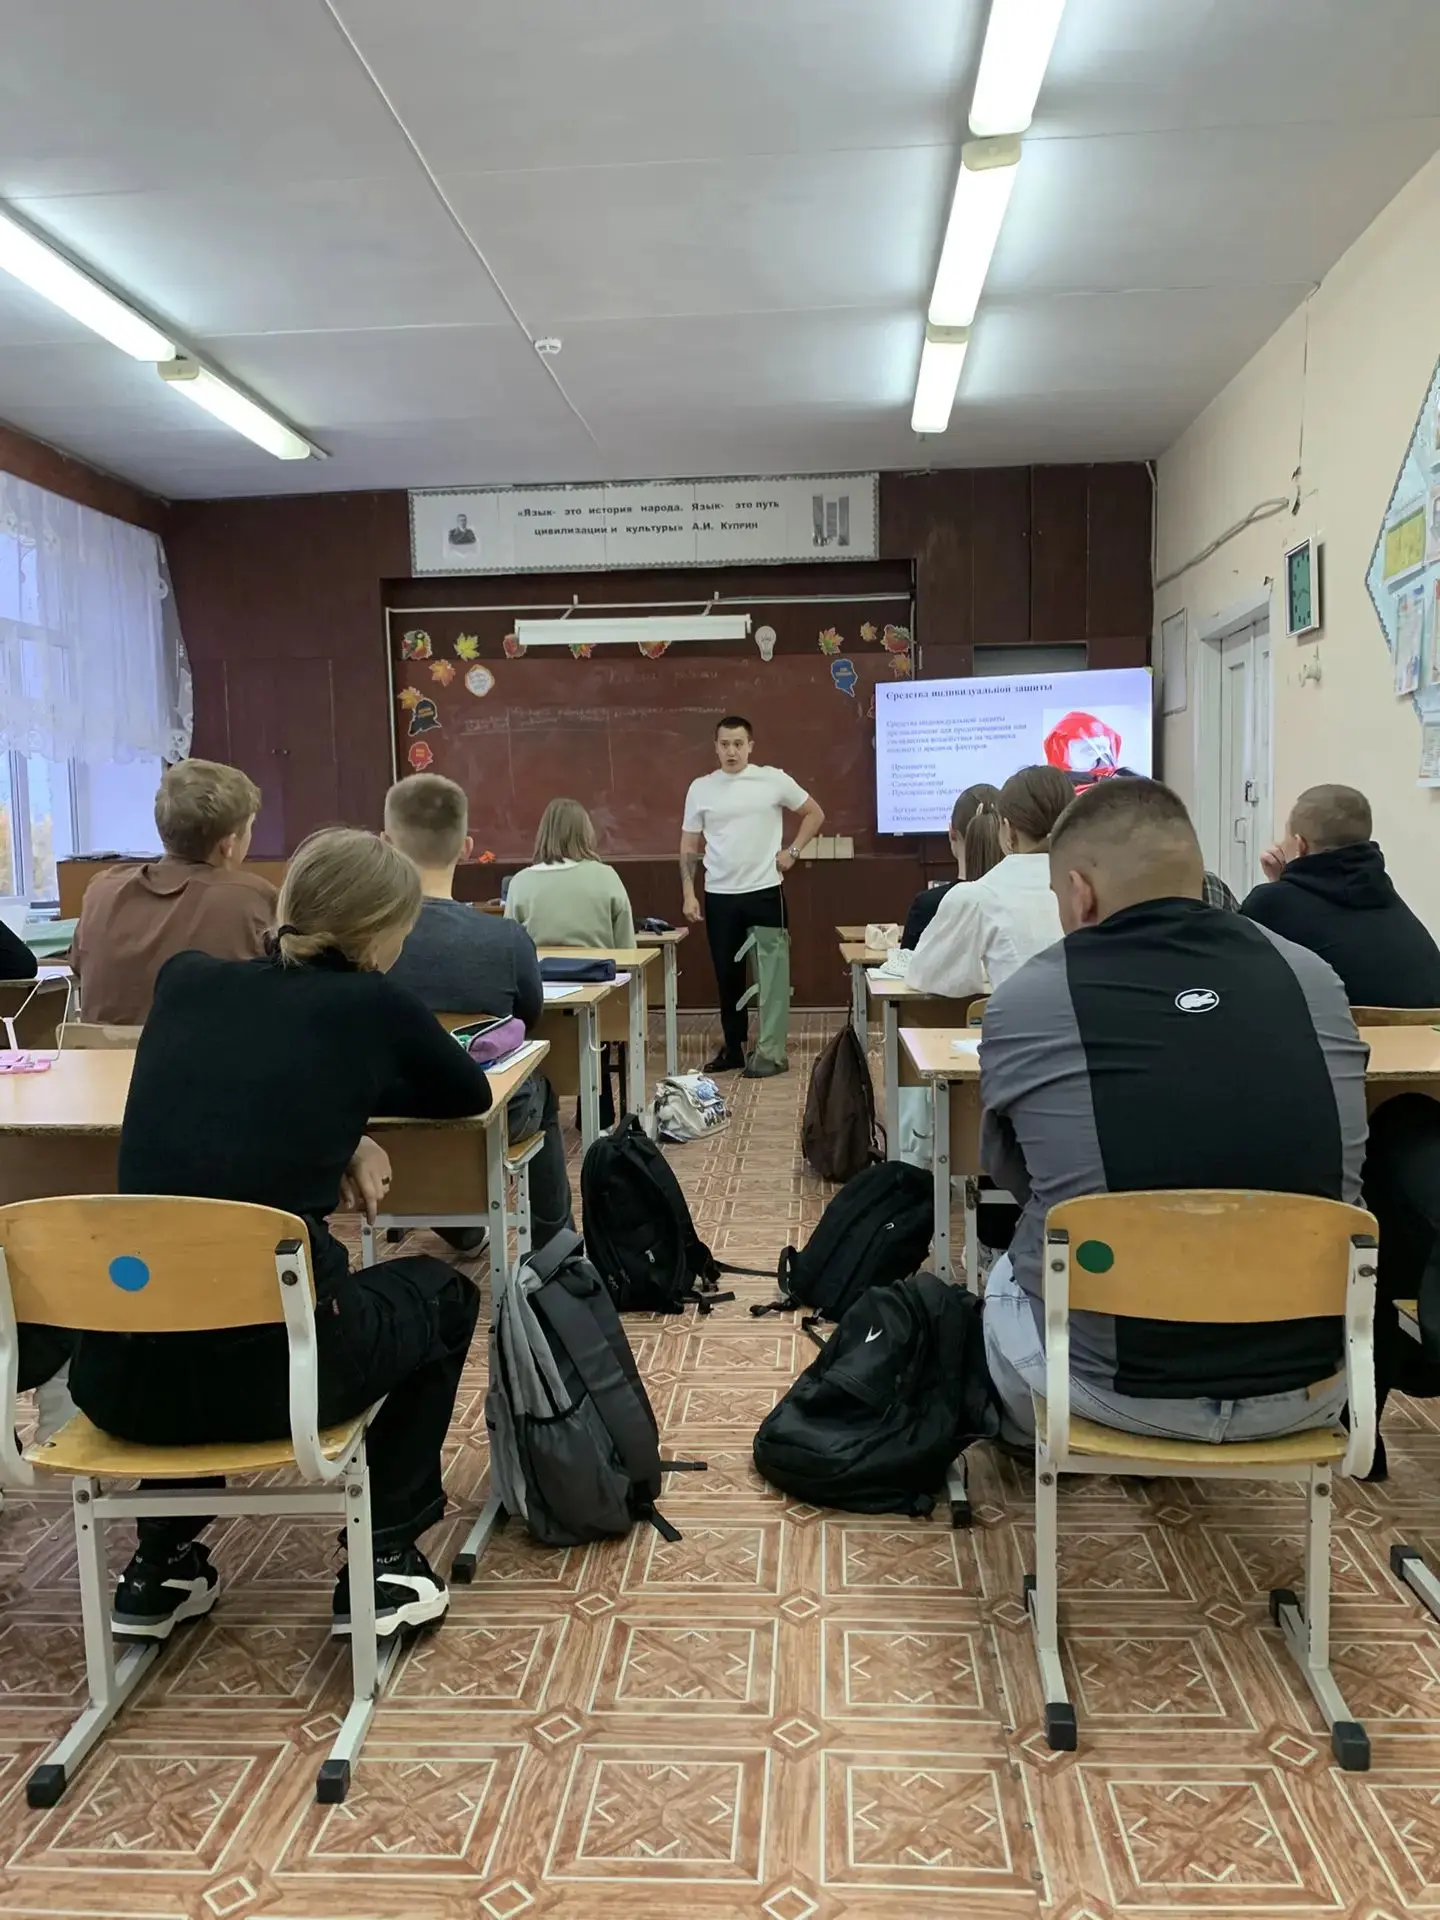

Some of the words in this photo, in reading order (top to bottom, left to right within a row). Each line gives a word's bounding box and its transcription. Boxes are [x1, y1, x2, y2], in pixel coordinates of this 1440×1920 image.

[517, 507, 556, 517] «Язык-
[564, 508, 582, 516] это
[588, 506, 632, 516] история
[640, 504, 684, 514] народа.
[691, 502, 725, 511] Язык-
[735, 501, 753, 509] это
[755, 500, 780, 510] путь
[534, 526, 608, 536] цивилизации
[625, 524, 684, 535] культуры»
[691, 522, 714, 531] А.И.
[886, 690, 929, 702] Средства
[931, 684, 1011, 698] индивидуальной
[1015, 683, 1053, 694] защиты
